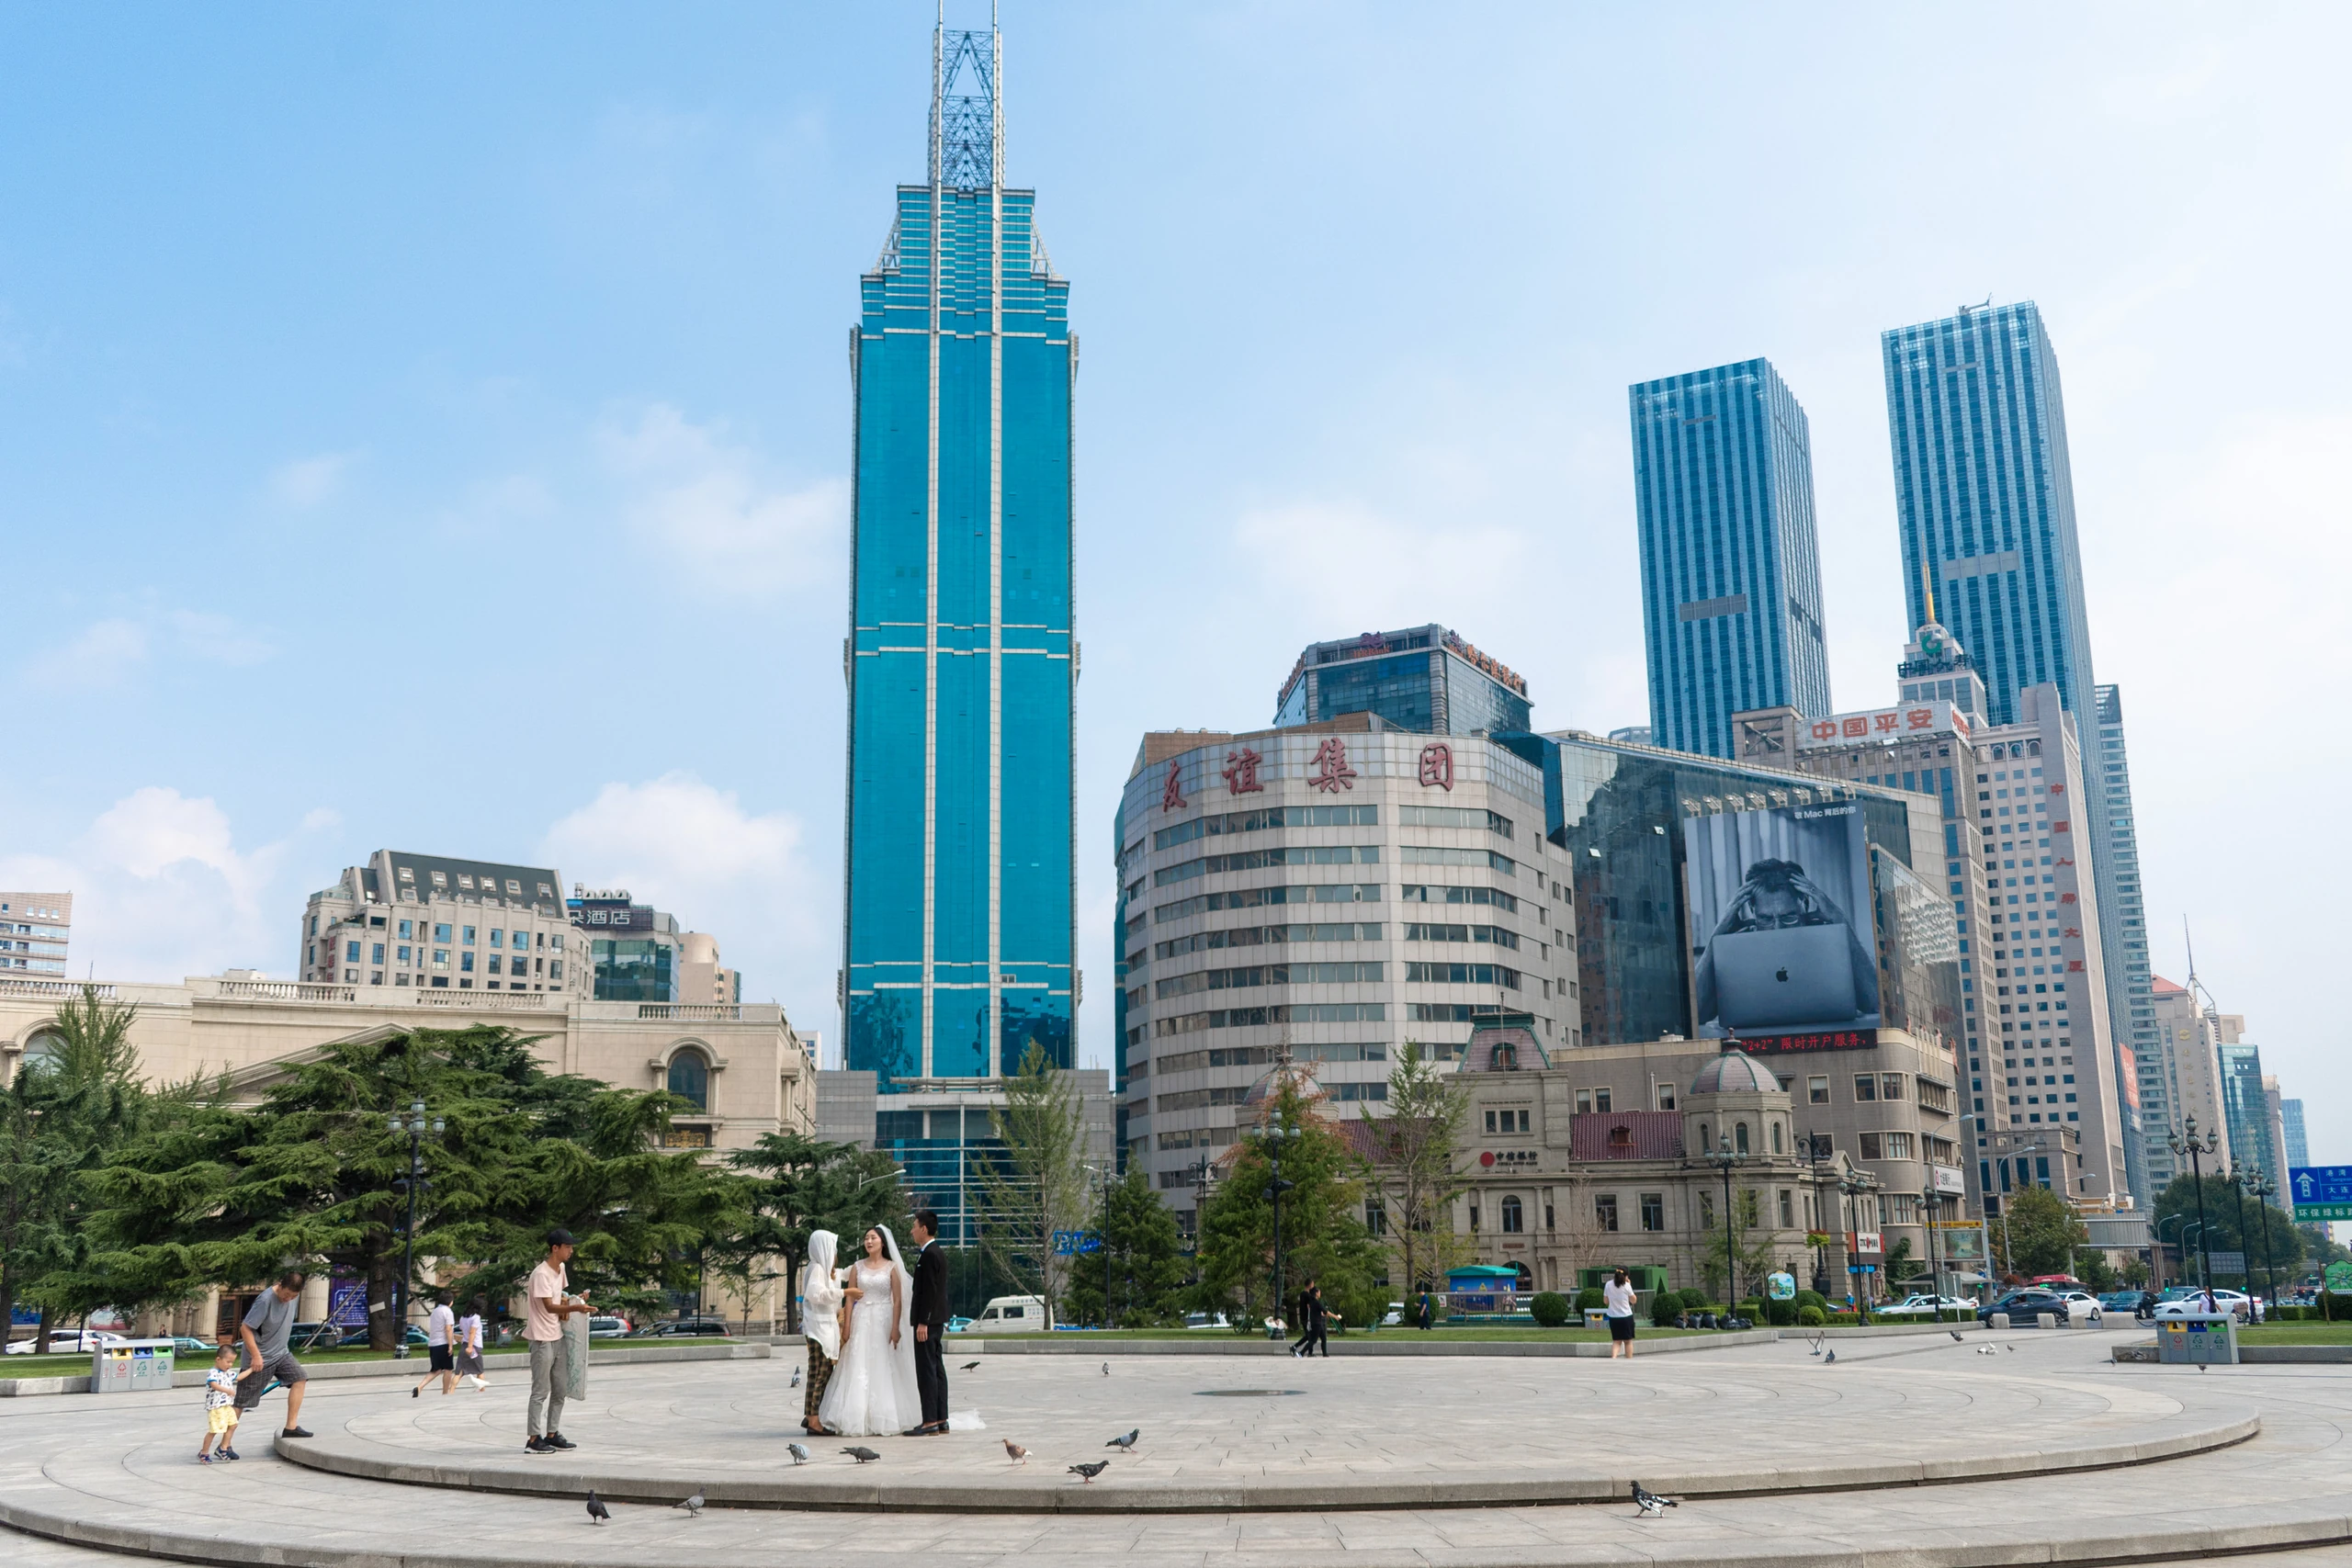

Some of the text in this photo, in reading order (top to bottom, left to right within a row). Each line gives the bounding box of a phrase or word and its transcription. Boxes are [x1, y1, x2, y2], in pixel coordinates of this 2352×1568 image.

[1812, 708, 1933, 741] 中国平安
[1163, 737, 1453, 812] 友谊集团
[1804, 809, 1823, 818] Mac
[2051, 784, 2086, 973] 中国人寿大厦
[1496, 1151, 1538, 1161] 中信银行
